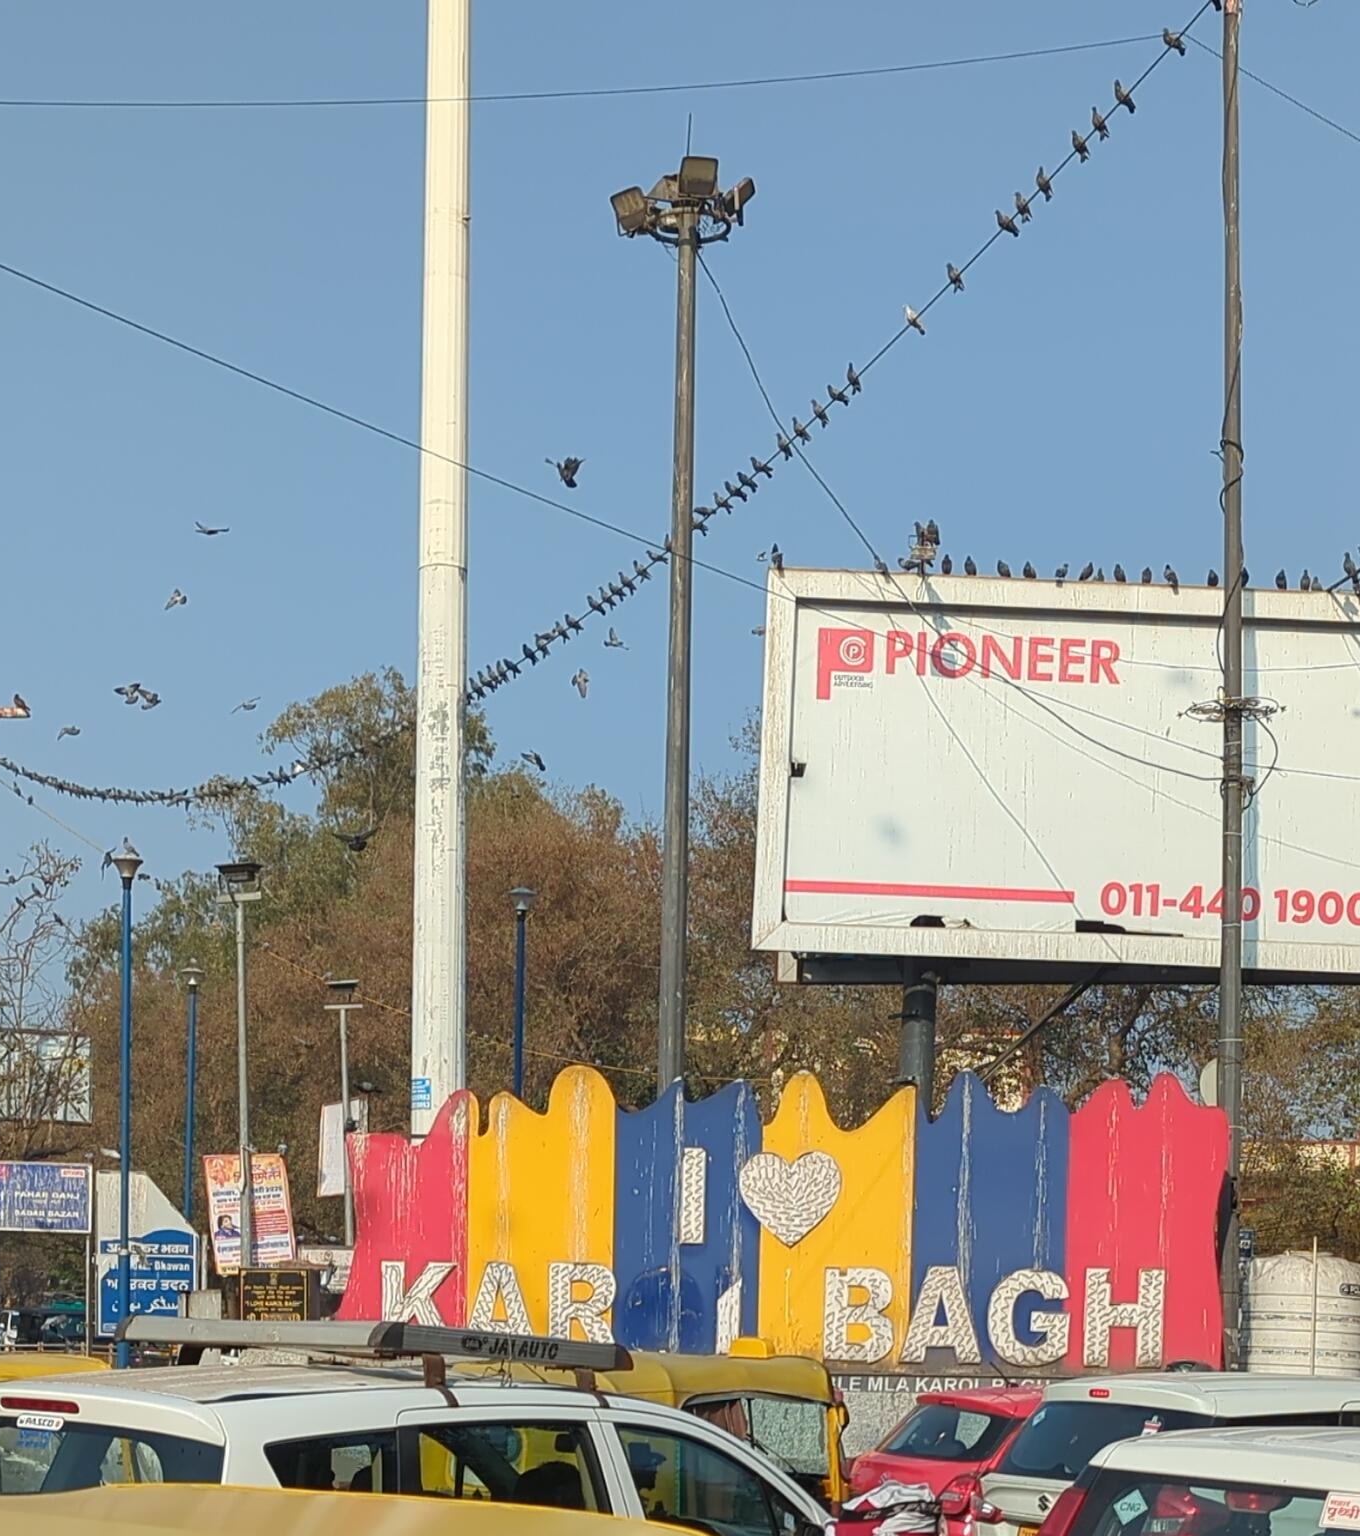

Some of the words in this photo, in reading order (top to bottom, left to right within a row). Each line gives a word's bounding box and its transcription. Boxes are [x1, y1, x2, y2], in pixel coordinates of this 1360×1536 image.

[885, 630, 1121, 684] PIONEER
[160, 1243, 189, 1254] भवन
[154, 1260, 190, 1272] Bhawan
[823, 1266, 1166, 1368] BAGH
[867, 1378, 910, 1393] MLA
[1119, 1500, 1143, 1513] CNG
